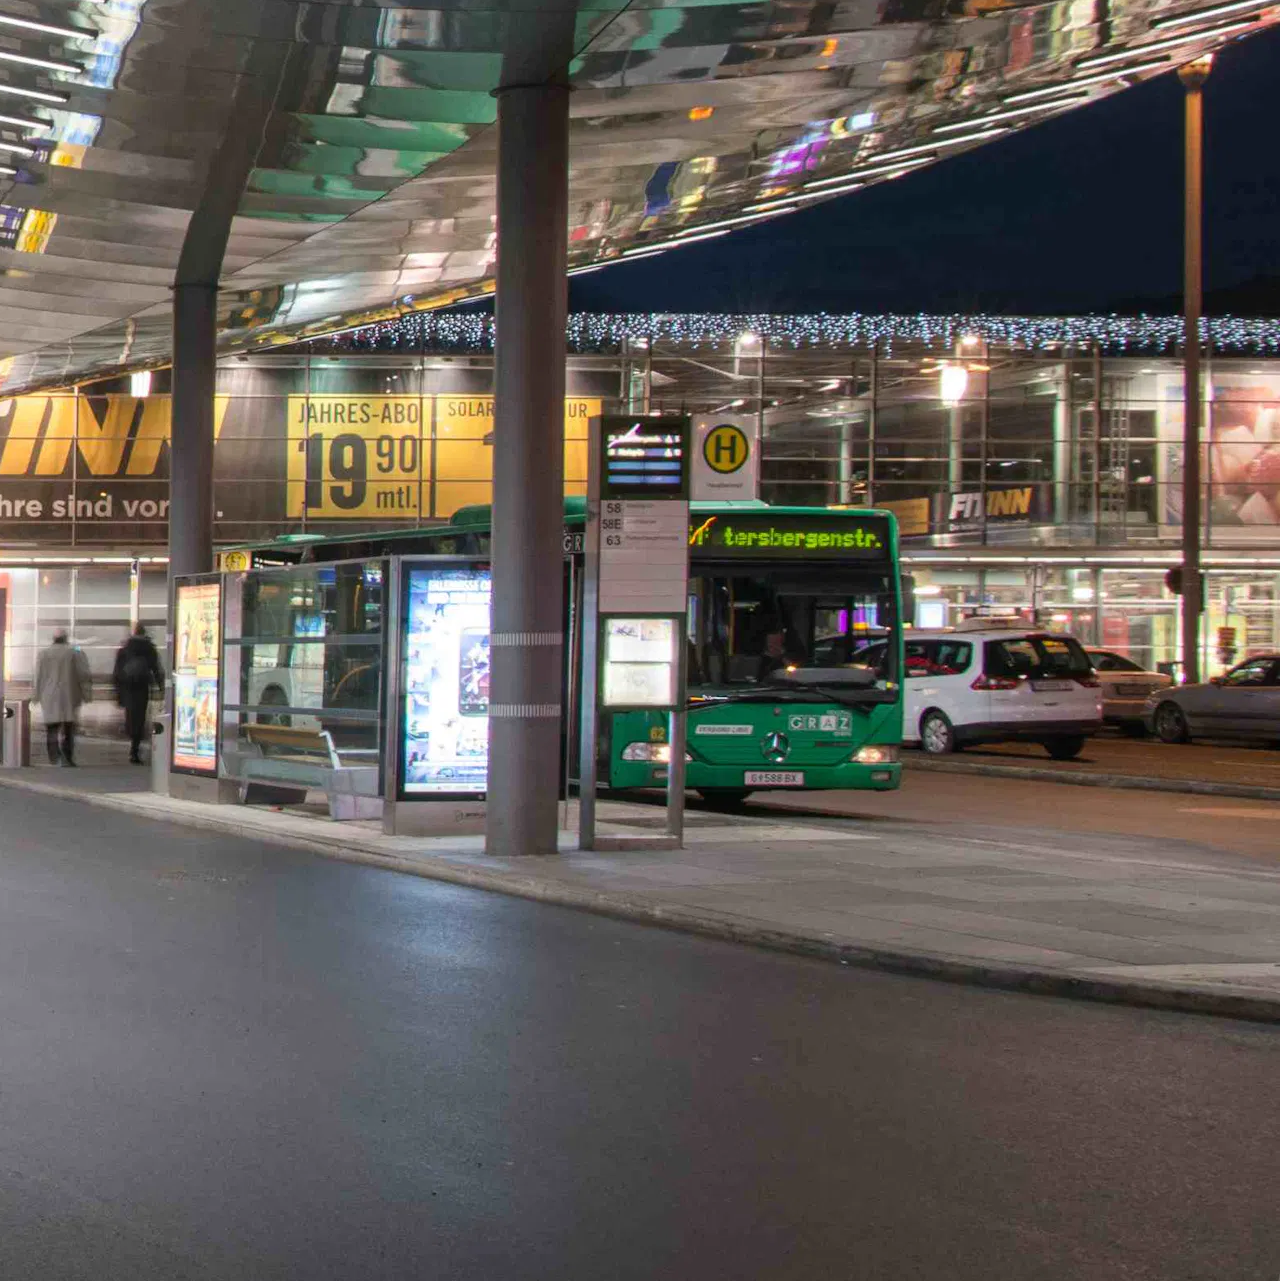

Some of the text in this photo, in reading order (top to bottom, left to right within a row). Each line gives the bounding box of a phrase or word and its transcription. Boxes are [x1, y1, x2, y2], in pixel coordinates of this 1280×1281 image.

[298, 402, 420, 424] JAHRES-ABO
[568, 403, 588, 418] UR
[714, 434, 737, 464] H
[297, 432, 419, 510] 19 90
[52, 495, 112, 518] sind
[122, 498, 225, 518] vor.
[375, 484, 418, 510] mtl.
[606, 502, 622, 514] 58
[602, 519, 622, 530] 58E
[606, 535, 622, 546] 63
[789, 715, 850, 730] GRAZ
